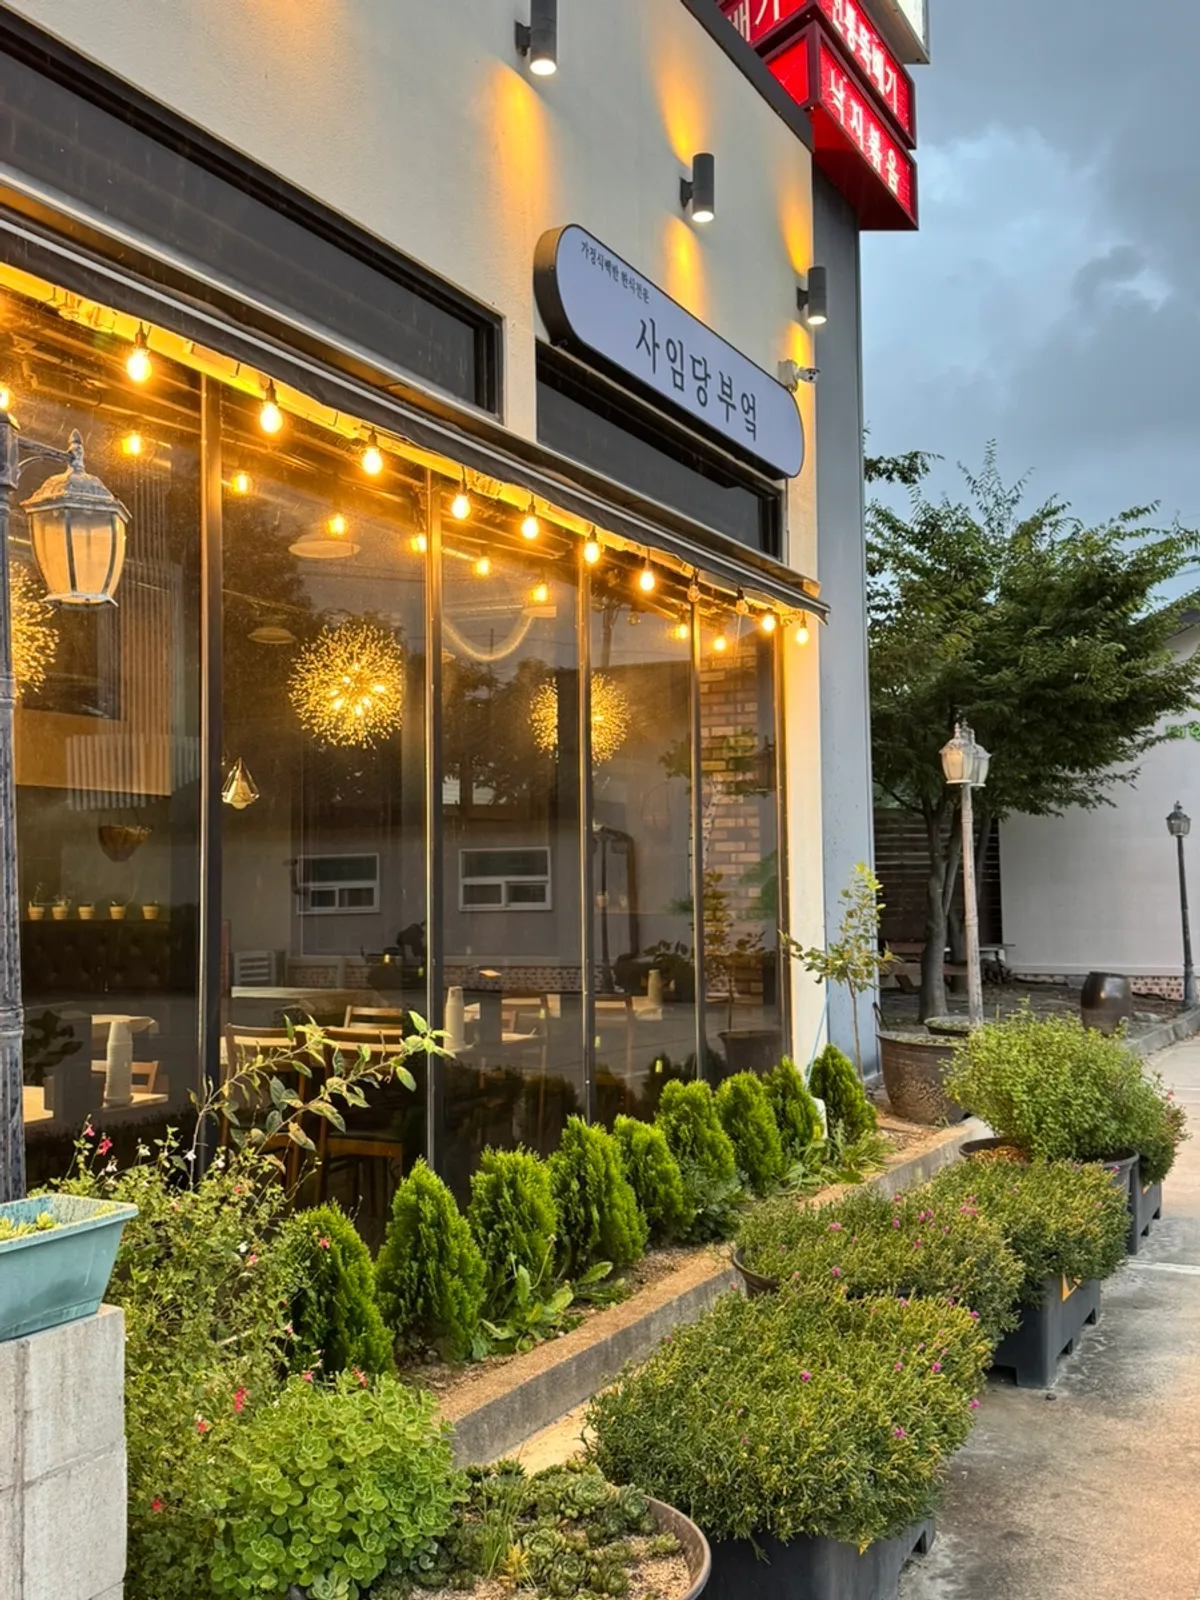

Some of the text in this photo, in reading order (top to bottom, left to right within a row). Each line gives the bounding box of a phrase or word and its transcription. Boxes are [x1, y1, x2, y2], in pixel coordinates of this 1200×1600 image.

[830, 68, 900, 195] 낙지볶음
[581, 241, 649, 305] 가정식백반 한식전문
[636, 318, 757, 442] 사임당부엌
